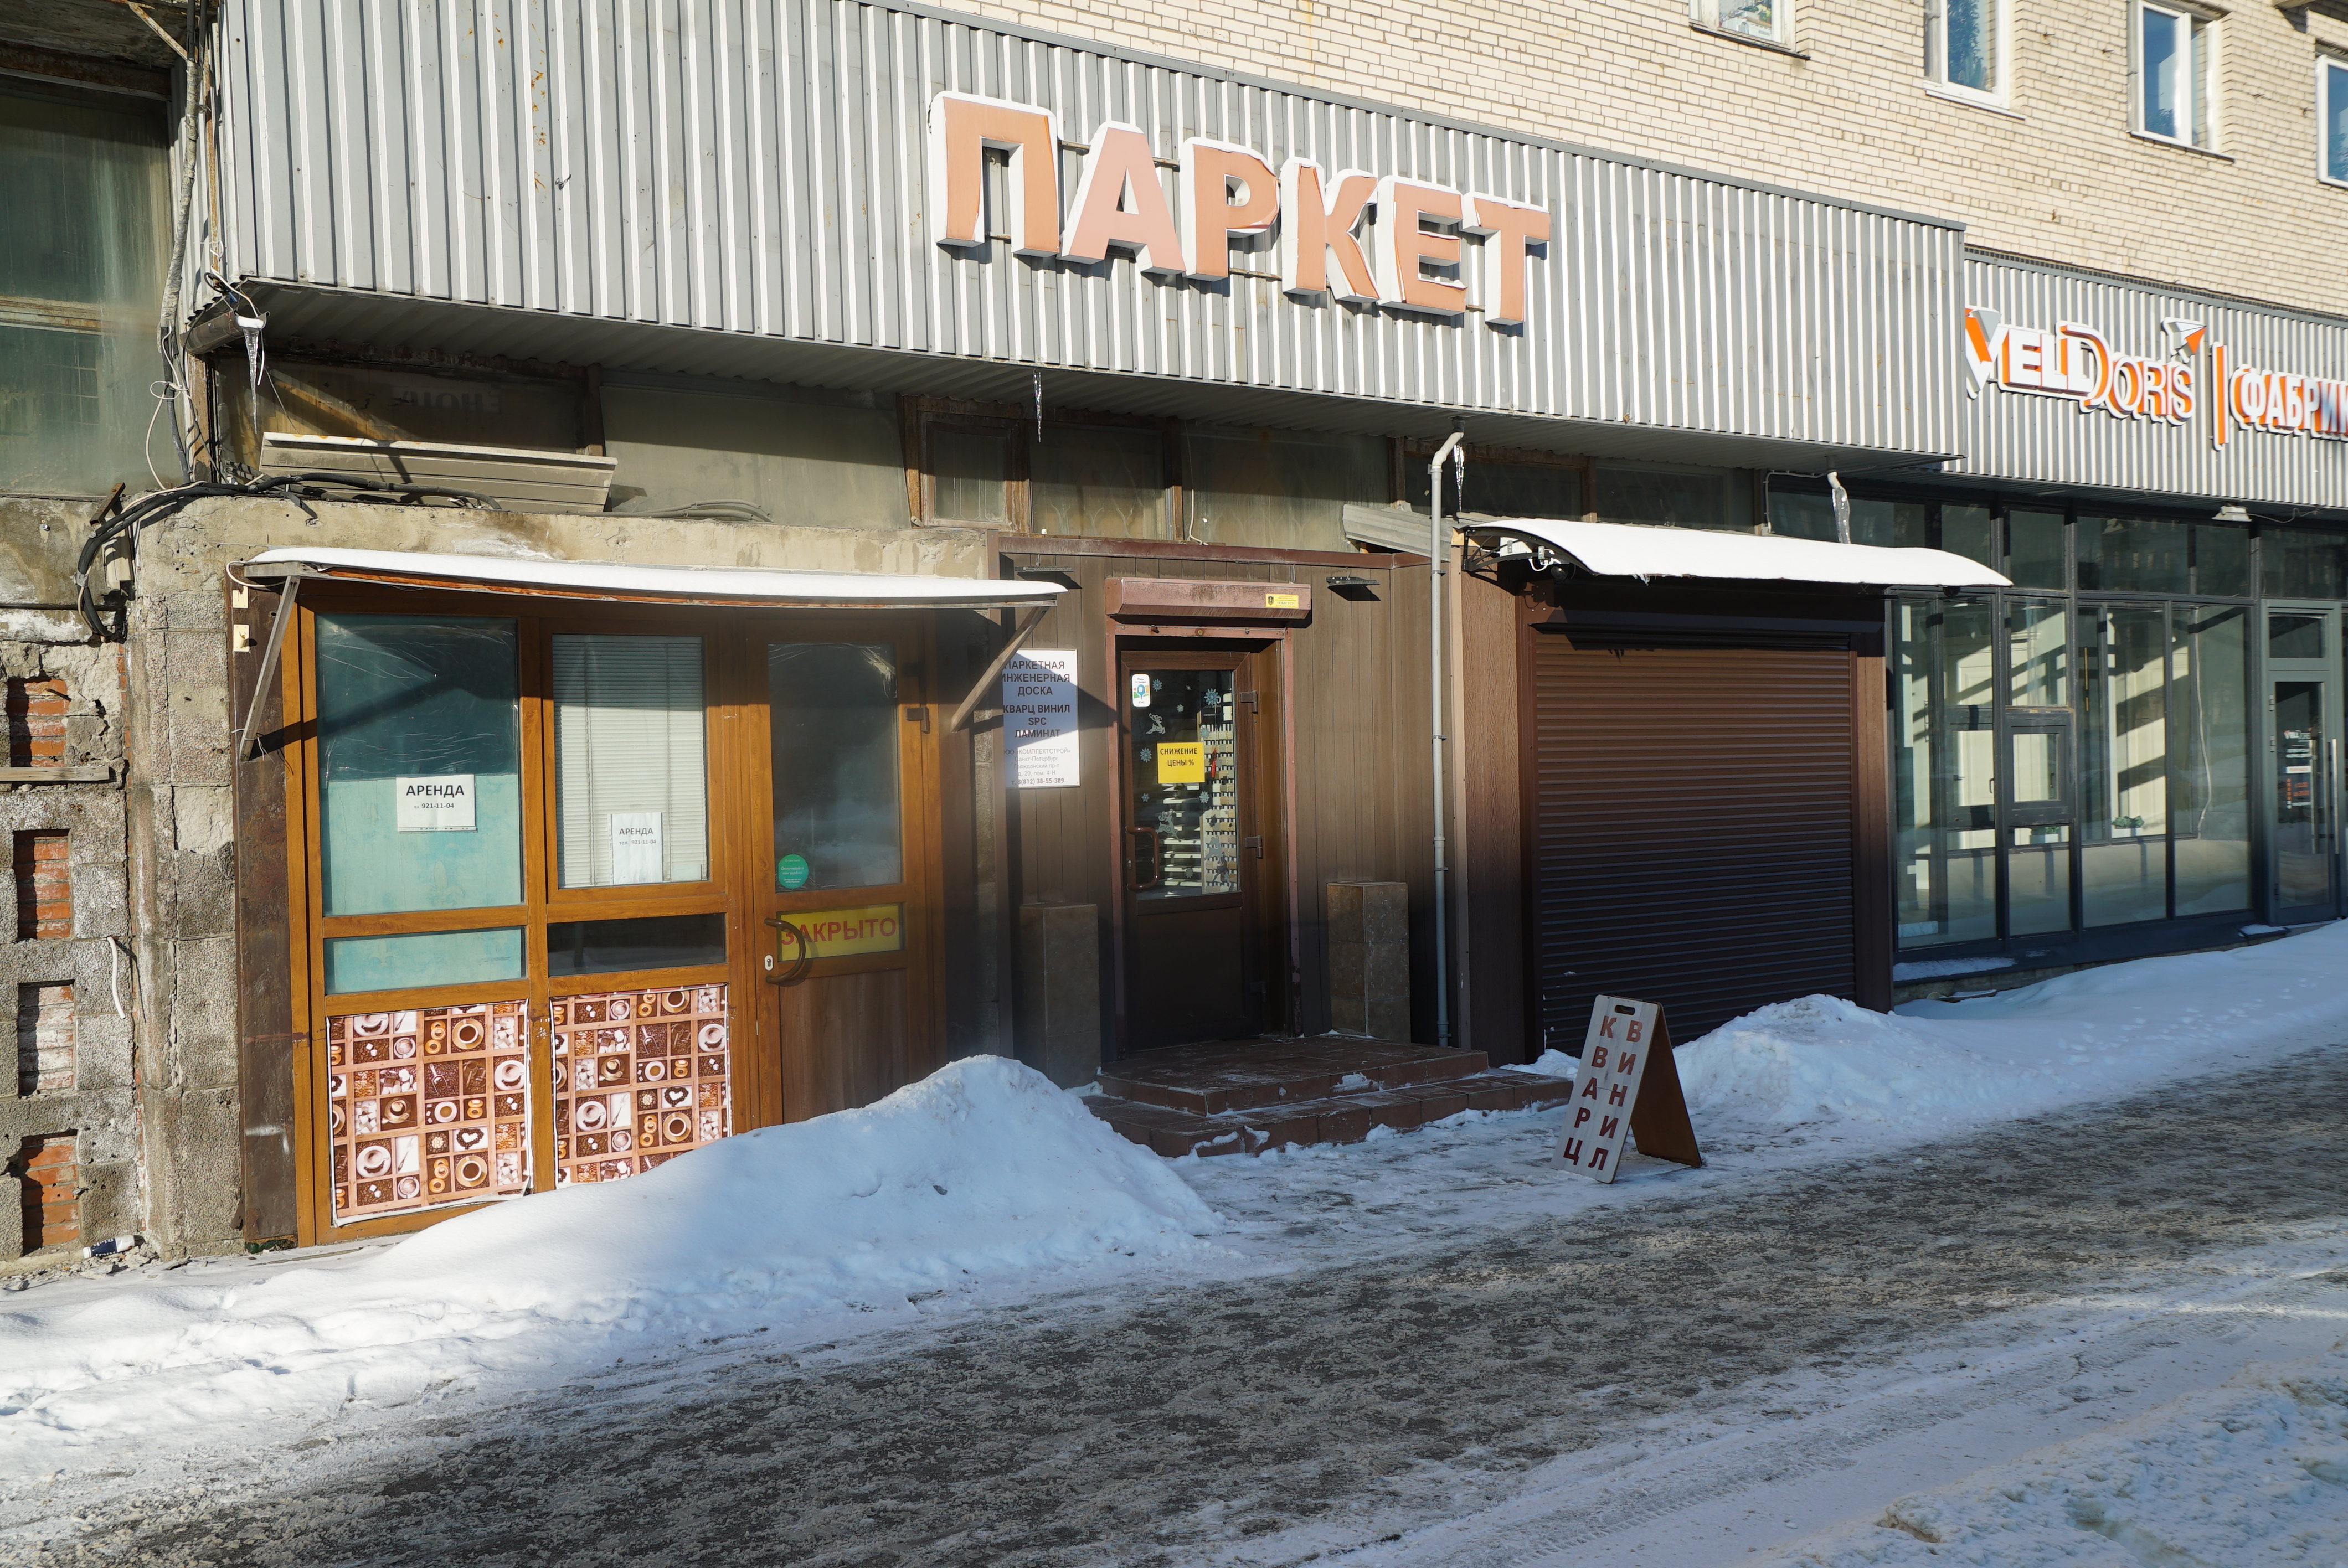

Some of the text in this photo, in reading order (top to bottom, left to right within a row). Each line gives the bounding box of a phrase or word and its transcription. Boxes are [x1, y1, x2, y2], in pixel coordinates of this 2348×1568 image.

[931, 91, 1550, 326] ПАРКЕТ
[1018, 686, 1053, 697] ДОСКА
[1003, 704, 1070, 715] КВАРЦ ВИНИЛ
[1028, 717, 1047, 725] SPC
[1014, 729, 1060, 738] ЛАМИНАТ
[1167, 759, 1187, 767] ЦЕНЫ
[406, 785, 465, 798] АРЕНДА
[619, 828, 653, 836] АРЕНДА
[781, 917, 897, 946] ЗАКРЫТО
[1563, 1015, 1617, 1165] КВАРЦ
[1588, 1020, 1643, 1171] ВИНИЛ
